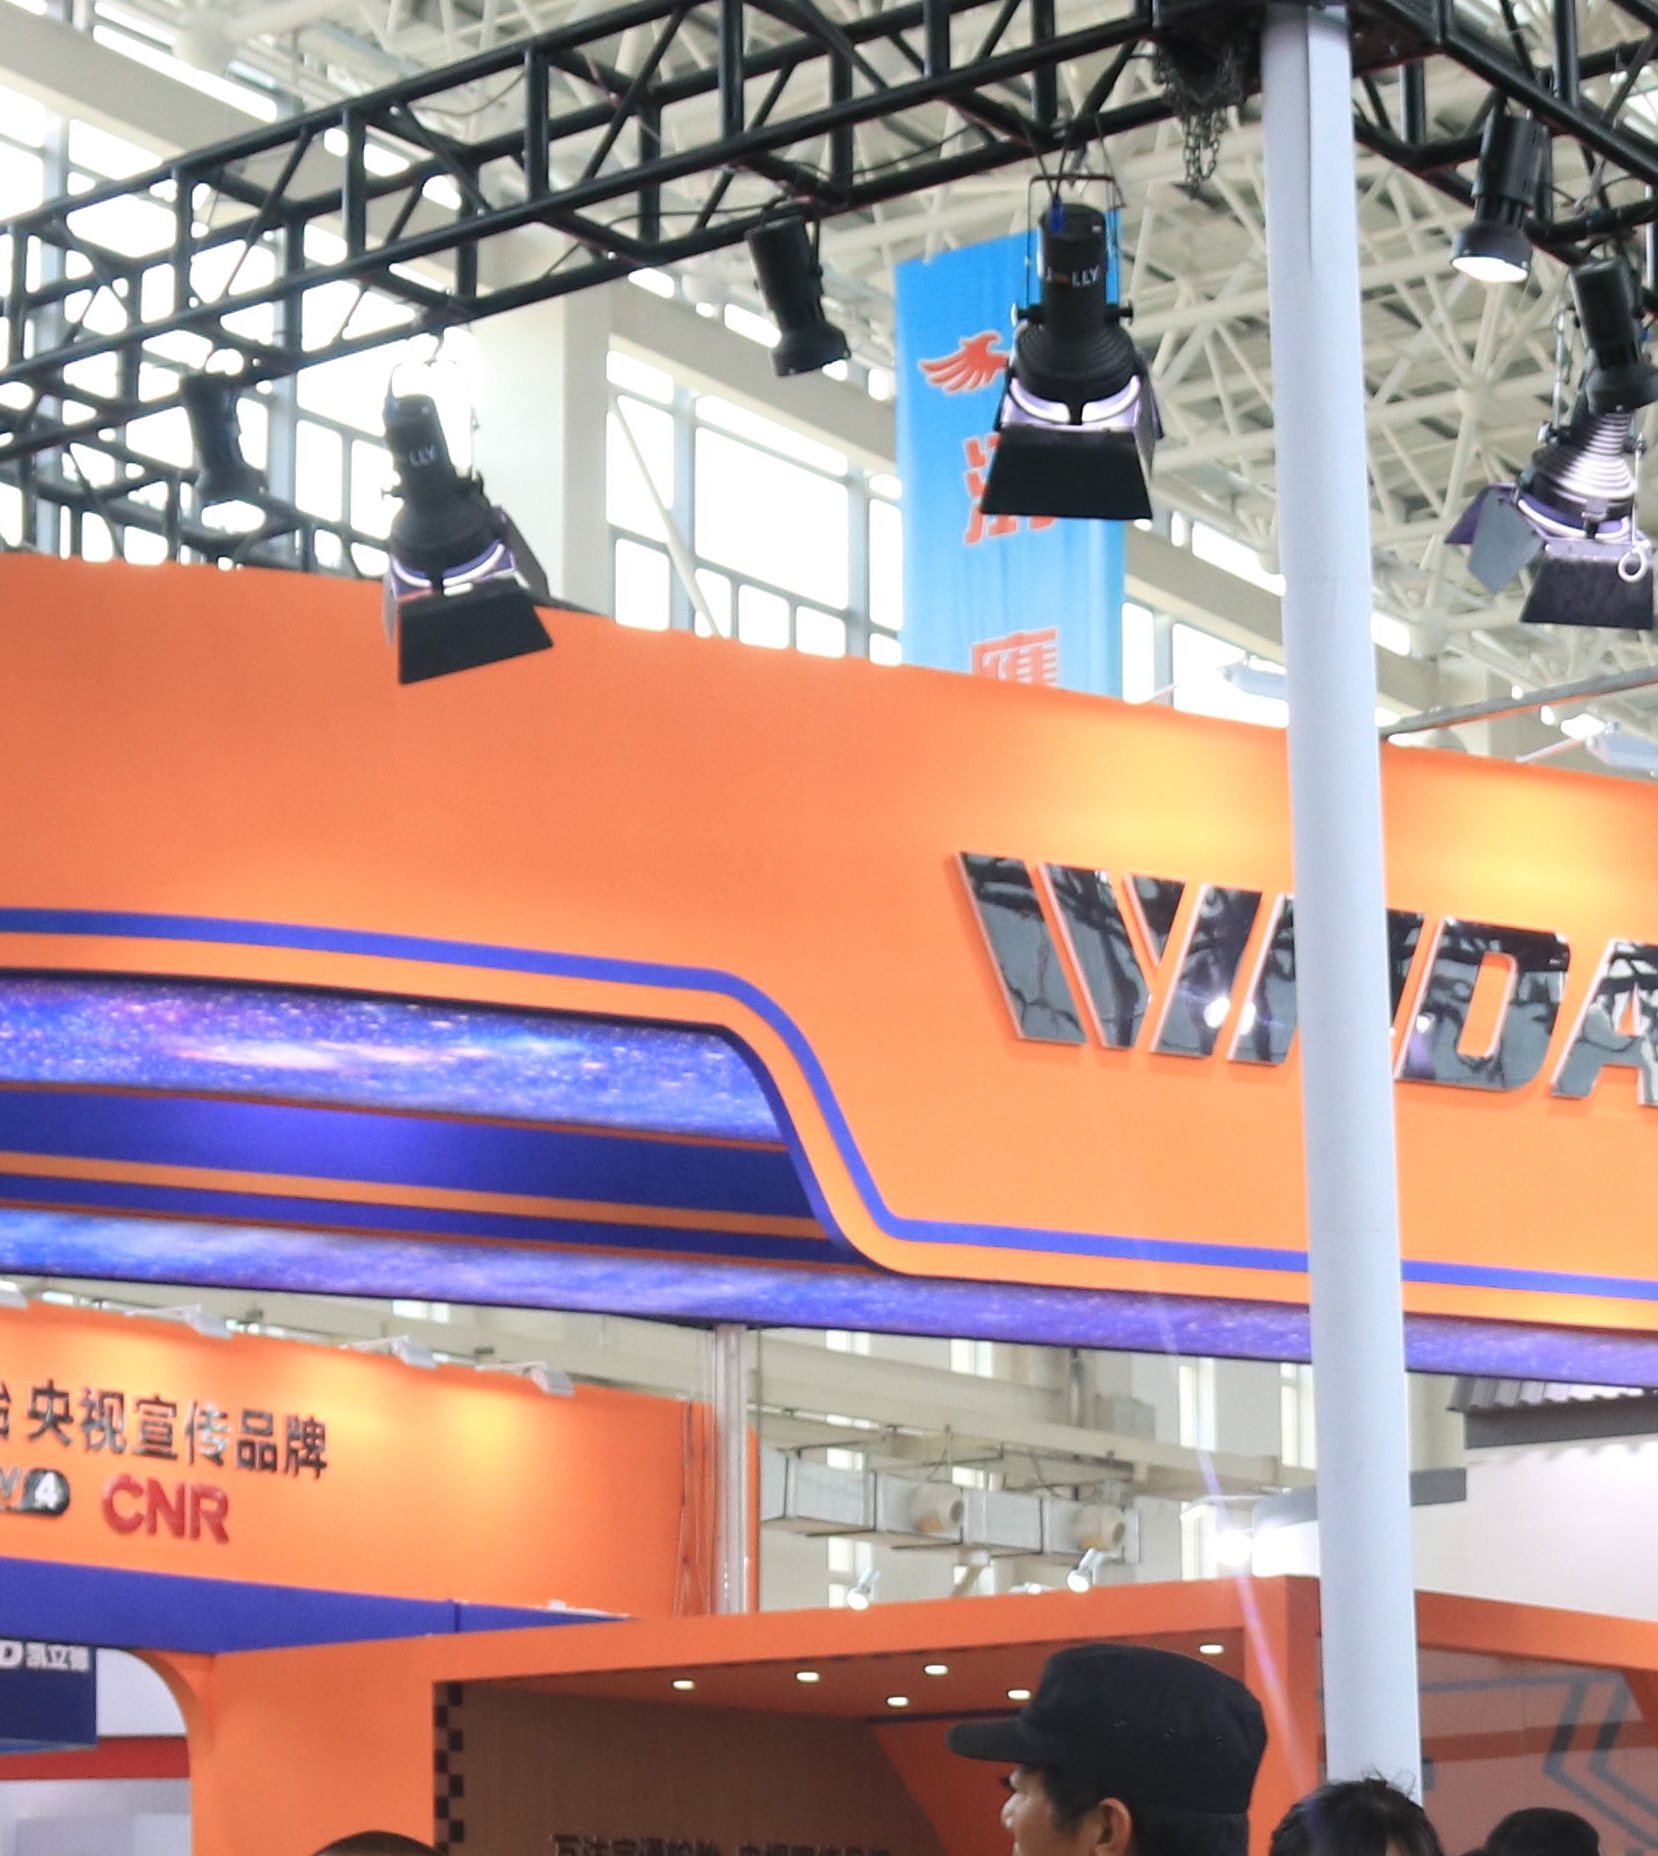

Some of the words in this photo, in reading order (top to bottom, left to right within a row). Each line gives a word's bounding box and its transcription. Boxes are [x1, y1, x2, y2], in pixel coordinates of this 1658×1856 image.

[26, 1378, 329, 1481] 央视宣传品牌
[101, 1472, 232, 1544] CNR
